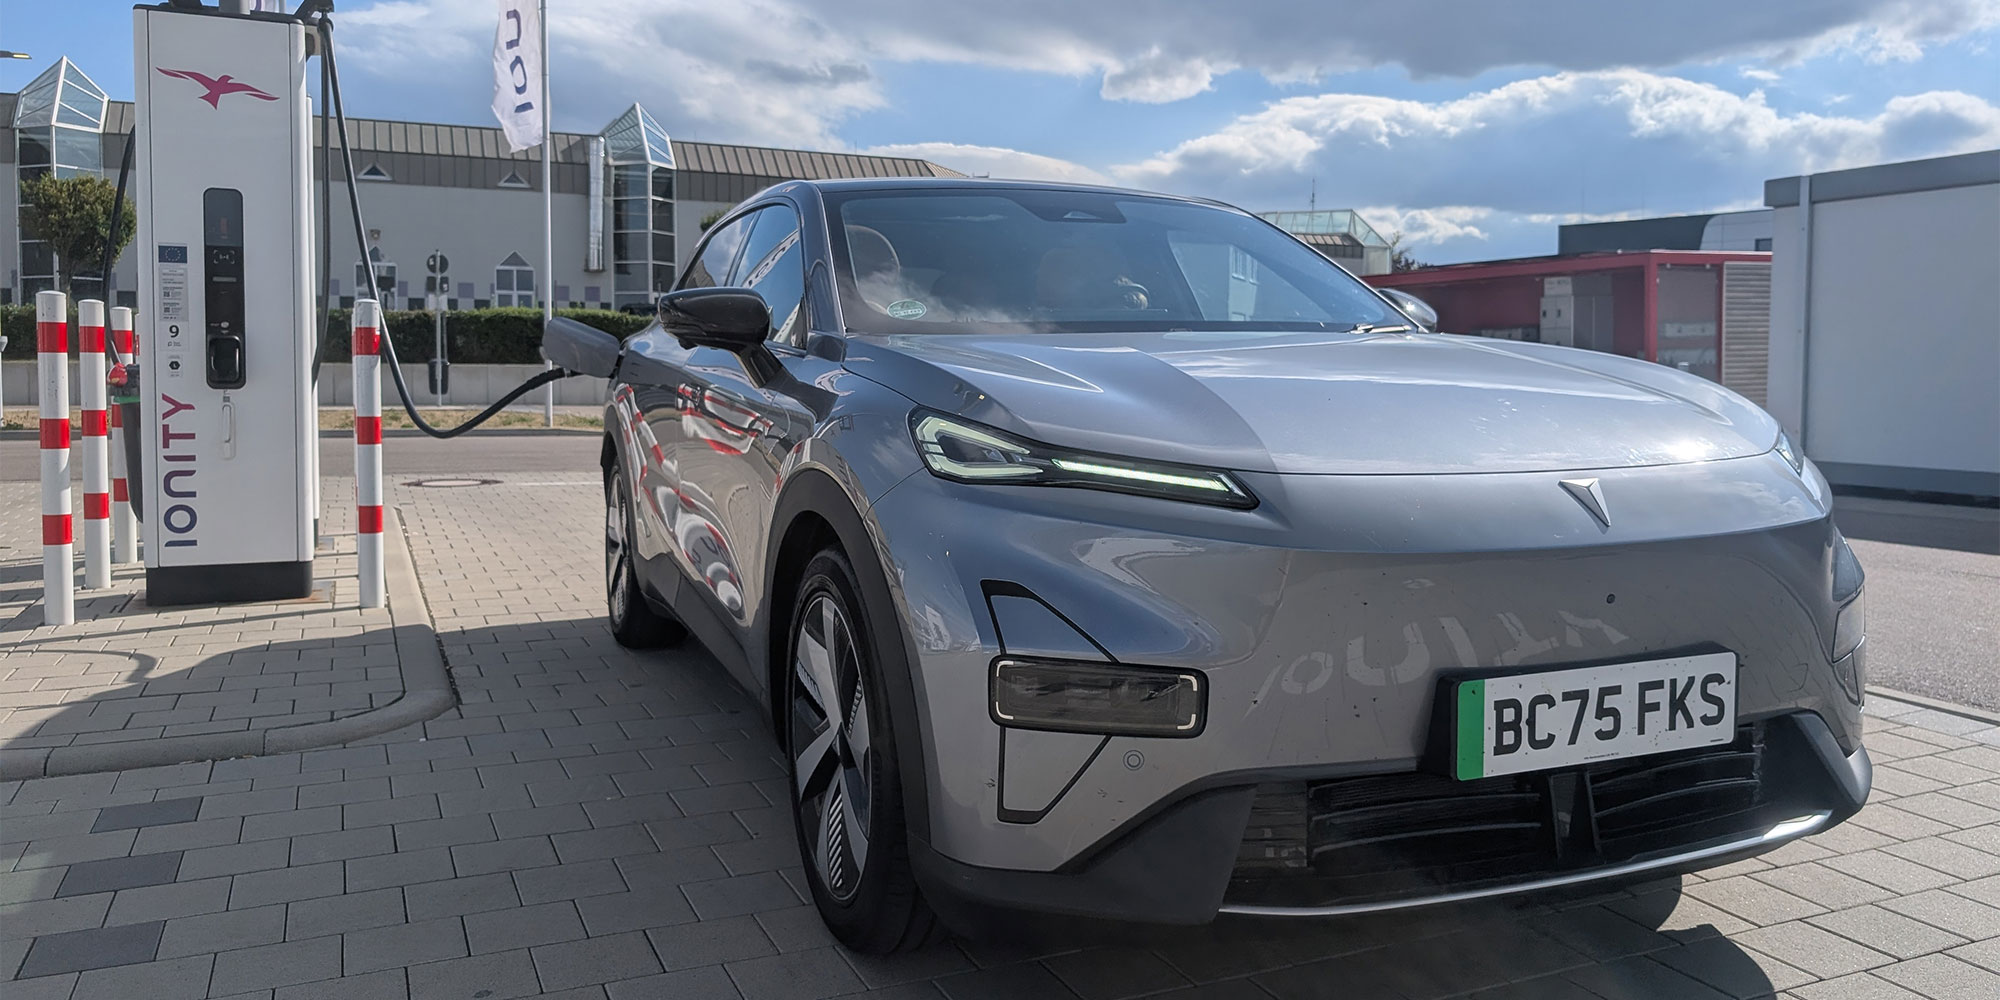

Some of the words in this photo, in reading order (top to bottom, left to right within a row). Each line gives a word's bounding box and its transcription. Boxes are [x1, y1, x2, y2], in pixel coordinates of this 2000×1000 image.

[169, 325, 179, 338] 9
[162, 393, 198, 547] IONITY
[1493, 684, 1622, 756] BC75
[1637, 673, 1726, 736] FKS
